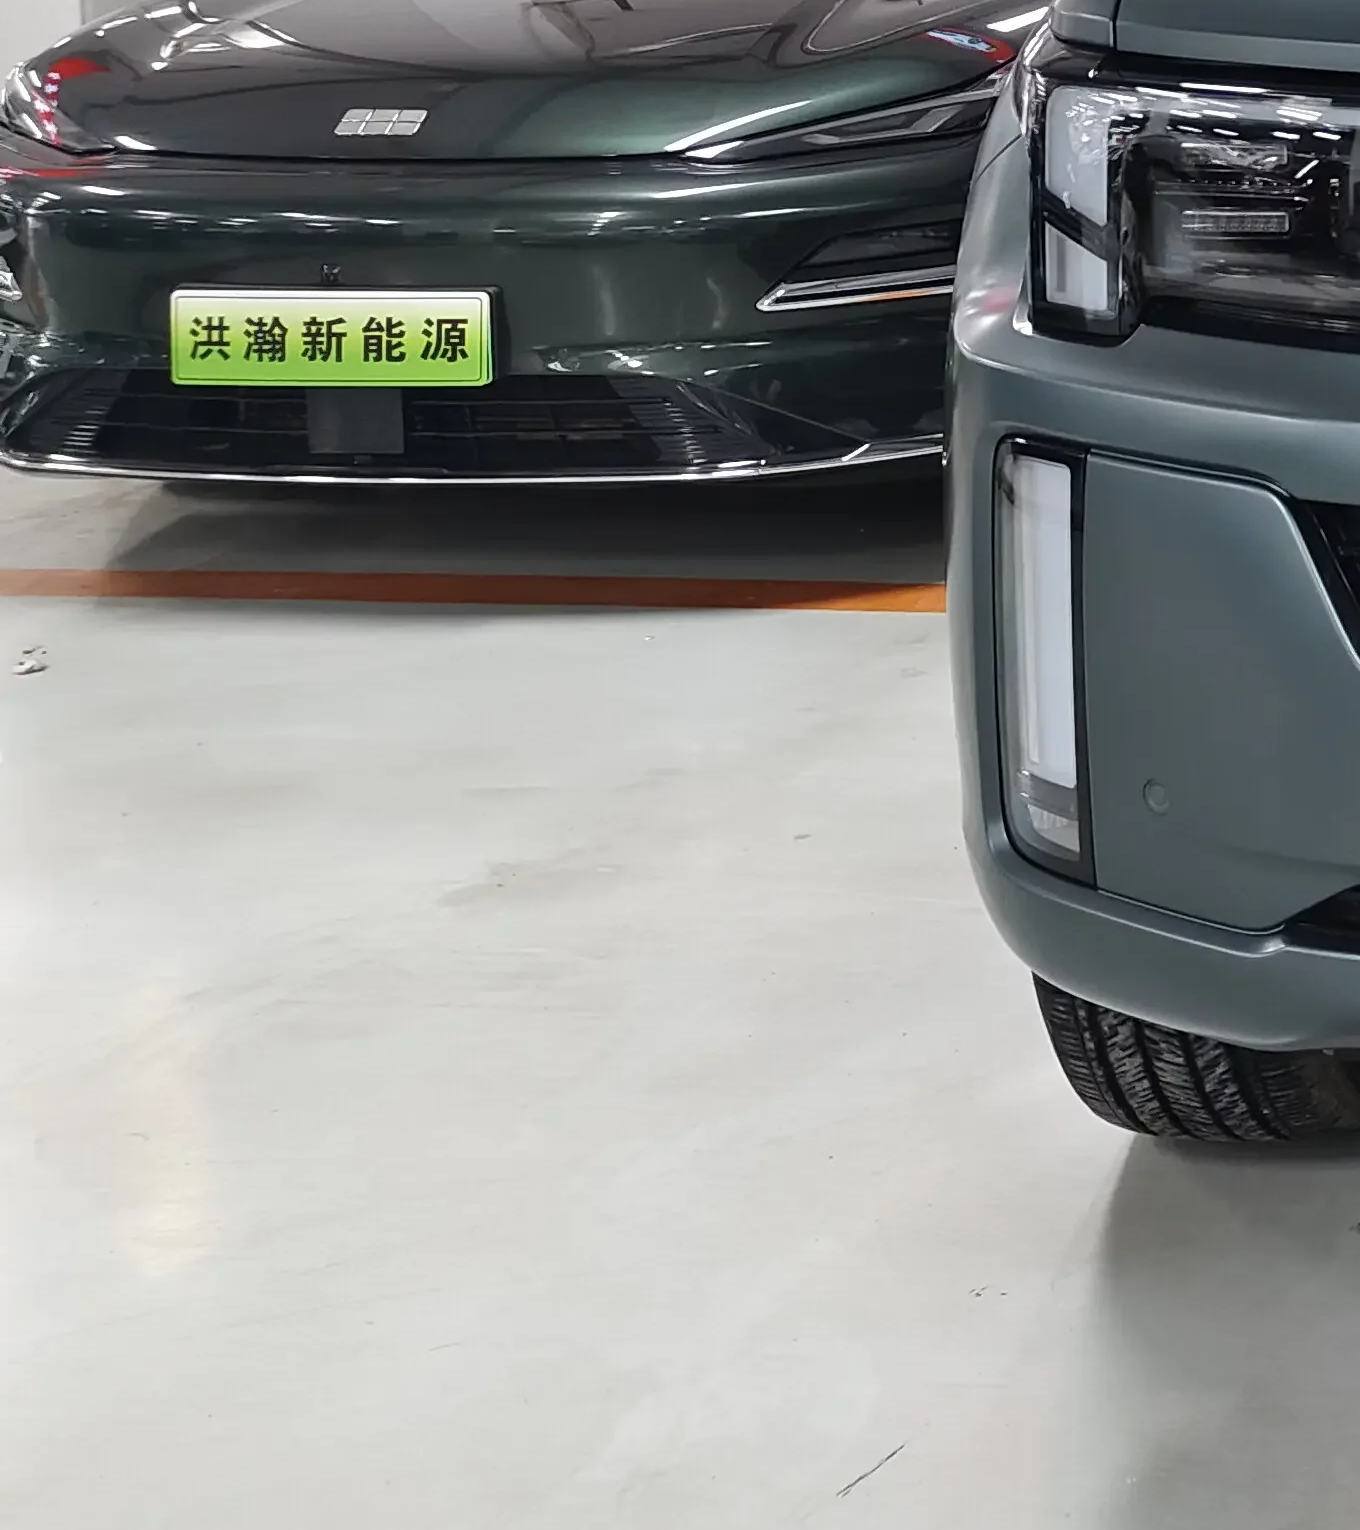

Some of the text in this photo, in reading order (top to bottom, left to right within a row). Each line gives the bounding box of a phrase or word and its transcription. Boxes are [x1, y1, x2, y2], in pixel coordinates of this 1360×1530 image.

[189, 316, 470, 363] 洪瀚新能源
